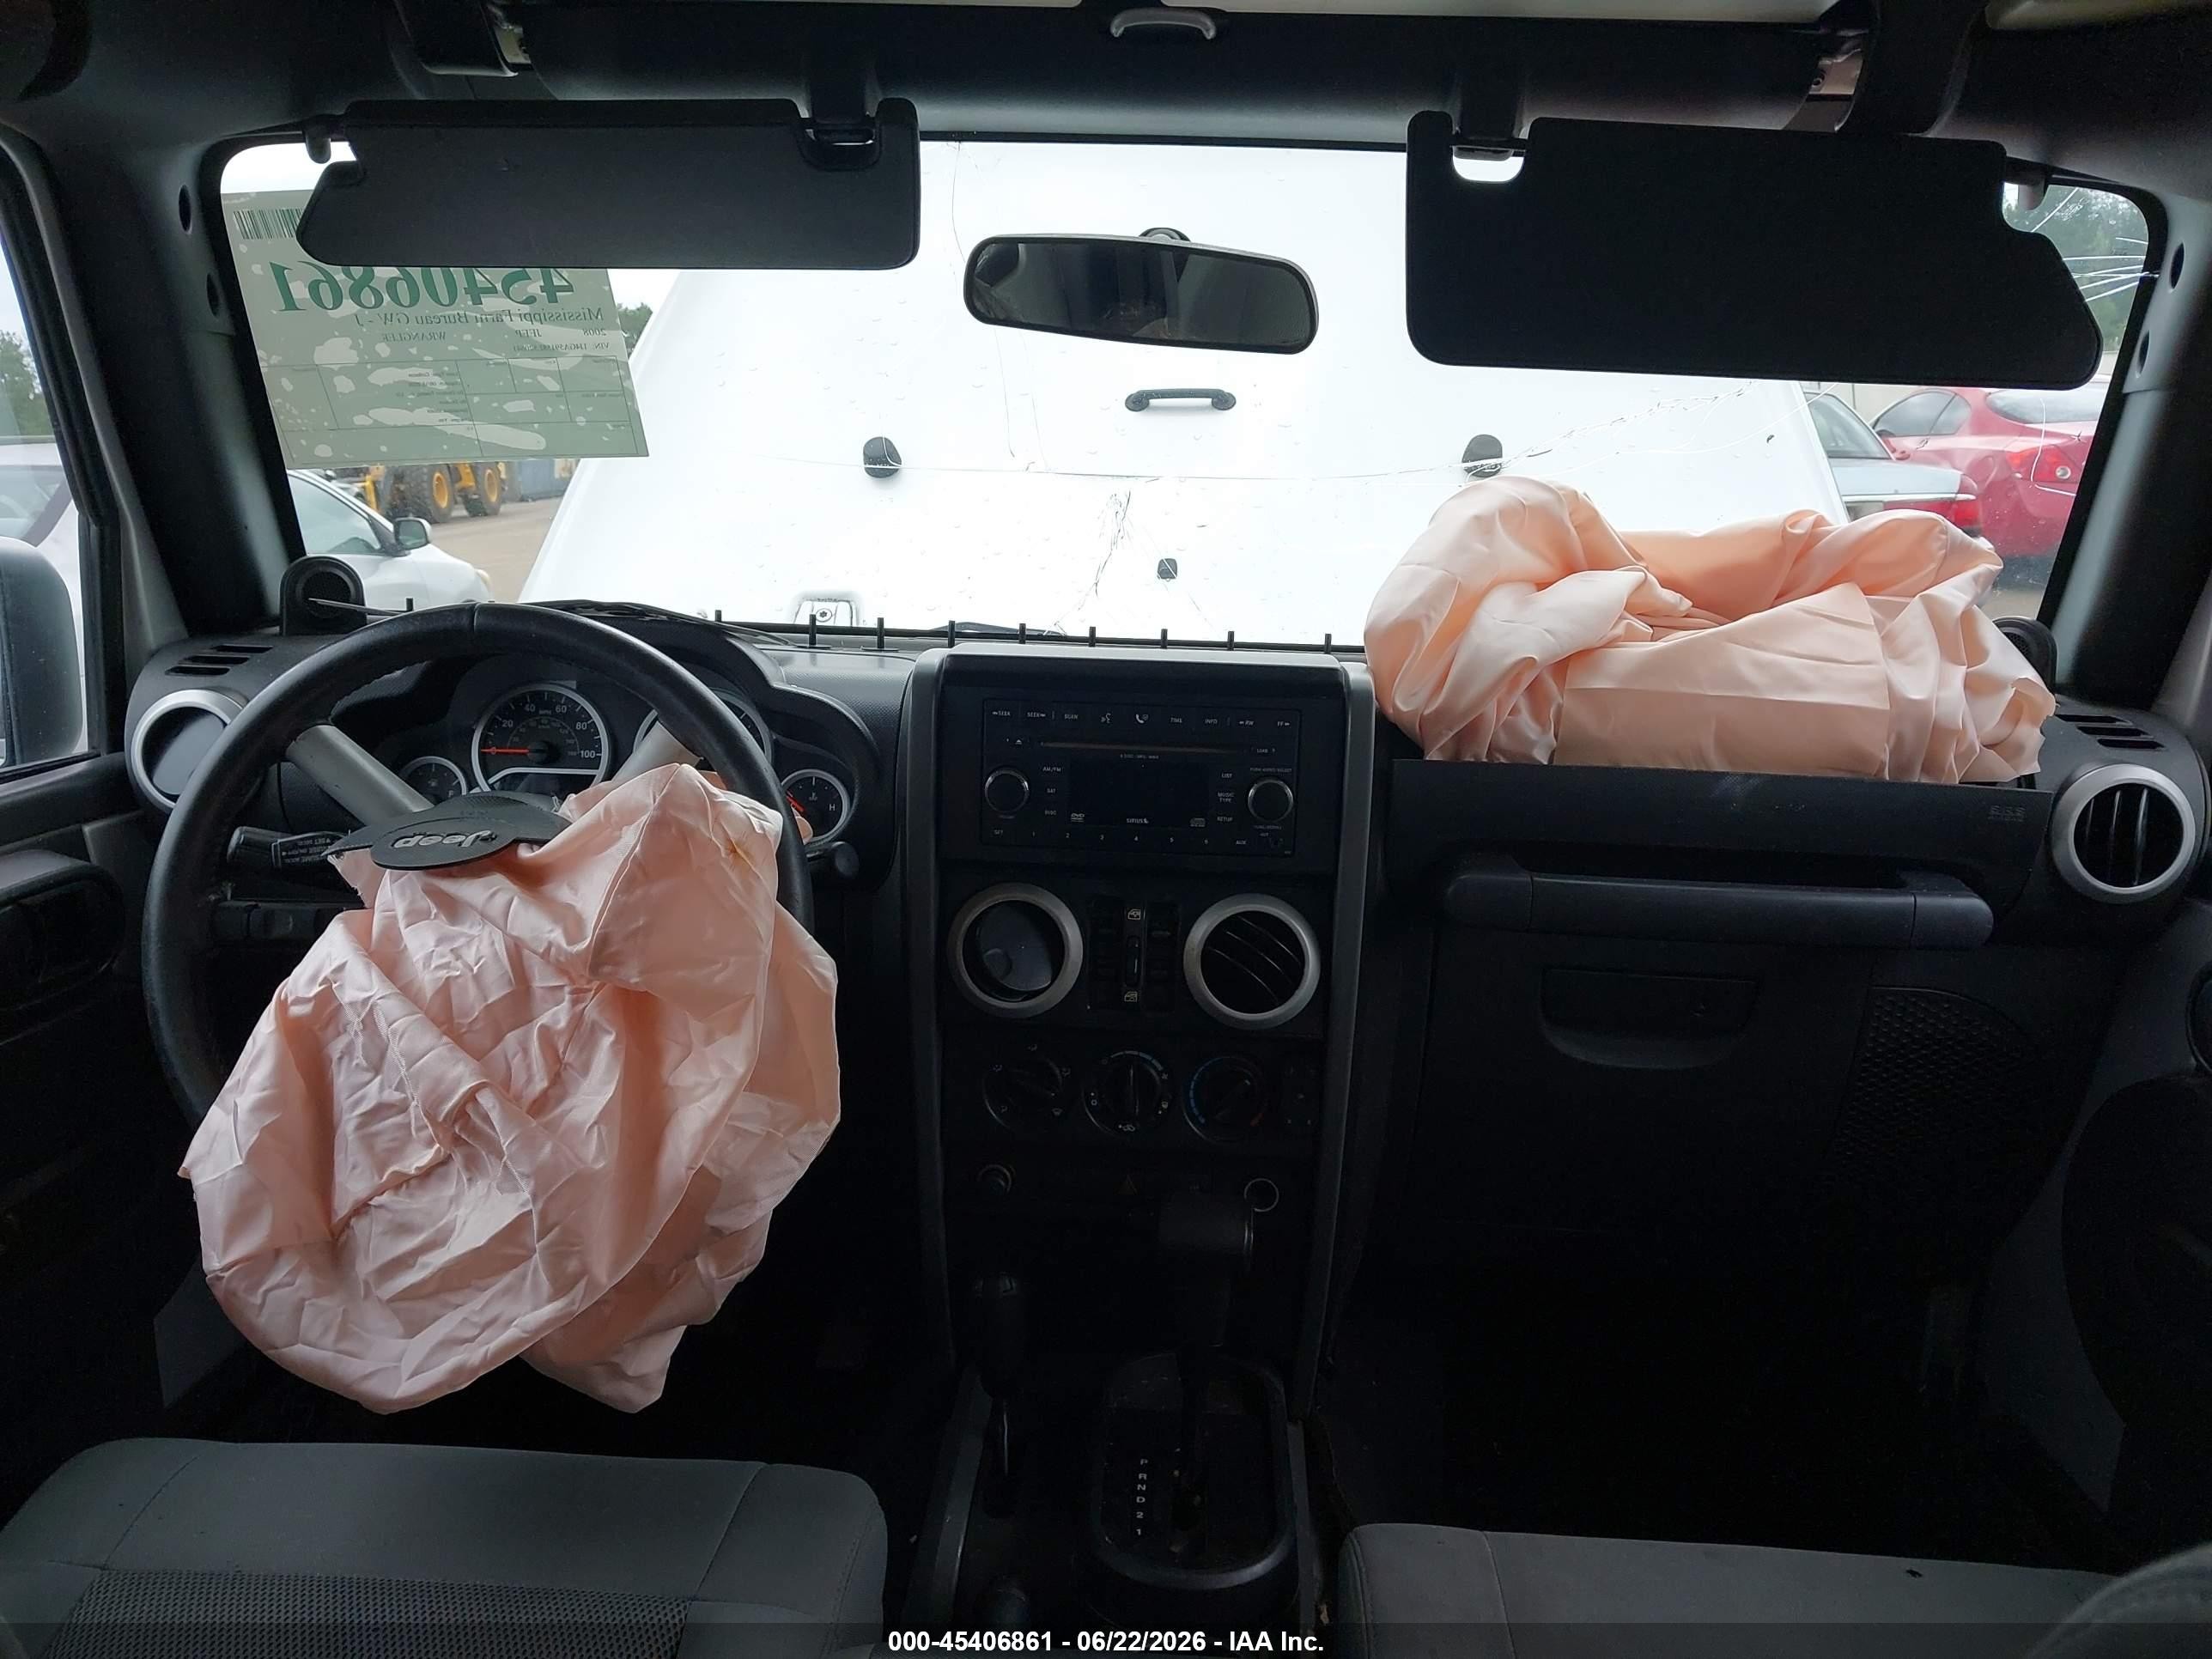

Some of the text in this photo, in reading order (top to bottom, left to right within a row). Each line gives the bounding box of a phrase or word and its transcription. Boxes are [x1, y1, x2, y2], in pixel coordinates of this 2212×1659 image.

[555, 704, 568, 714] 60
[502, 720, 514, 728] 20
[580, 749, 596, 759] 100
[394, 830, 491, 848] Jeep
